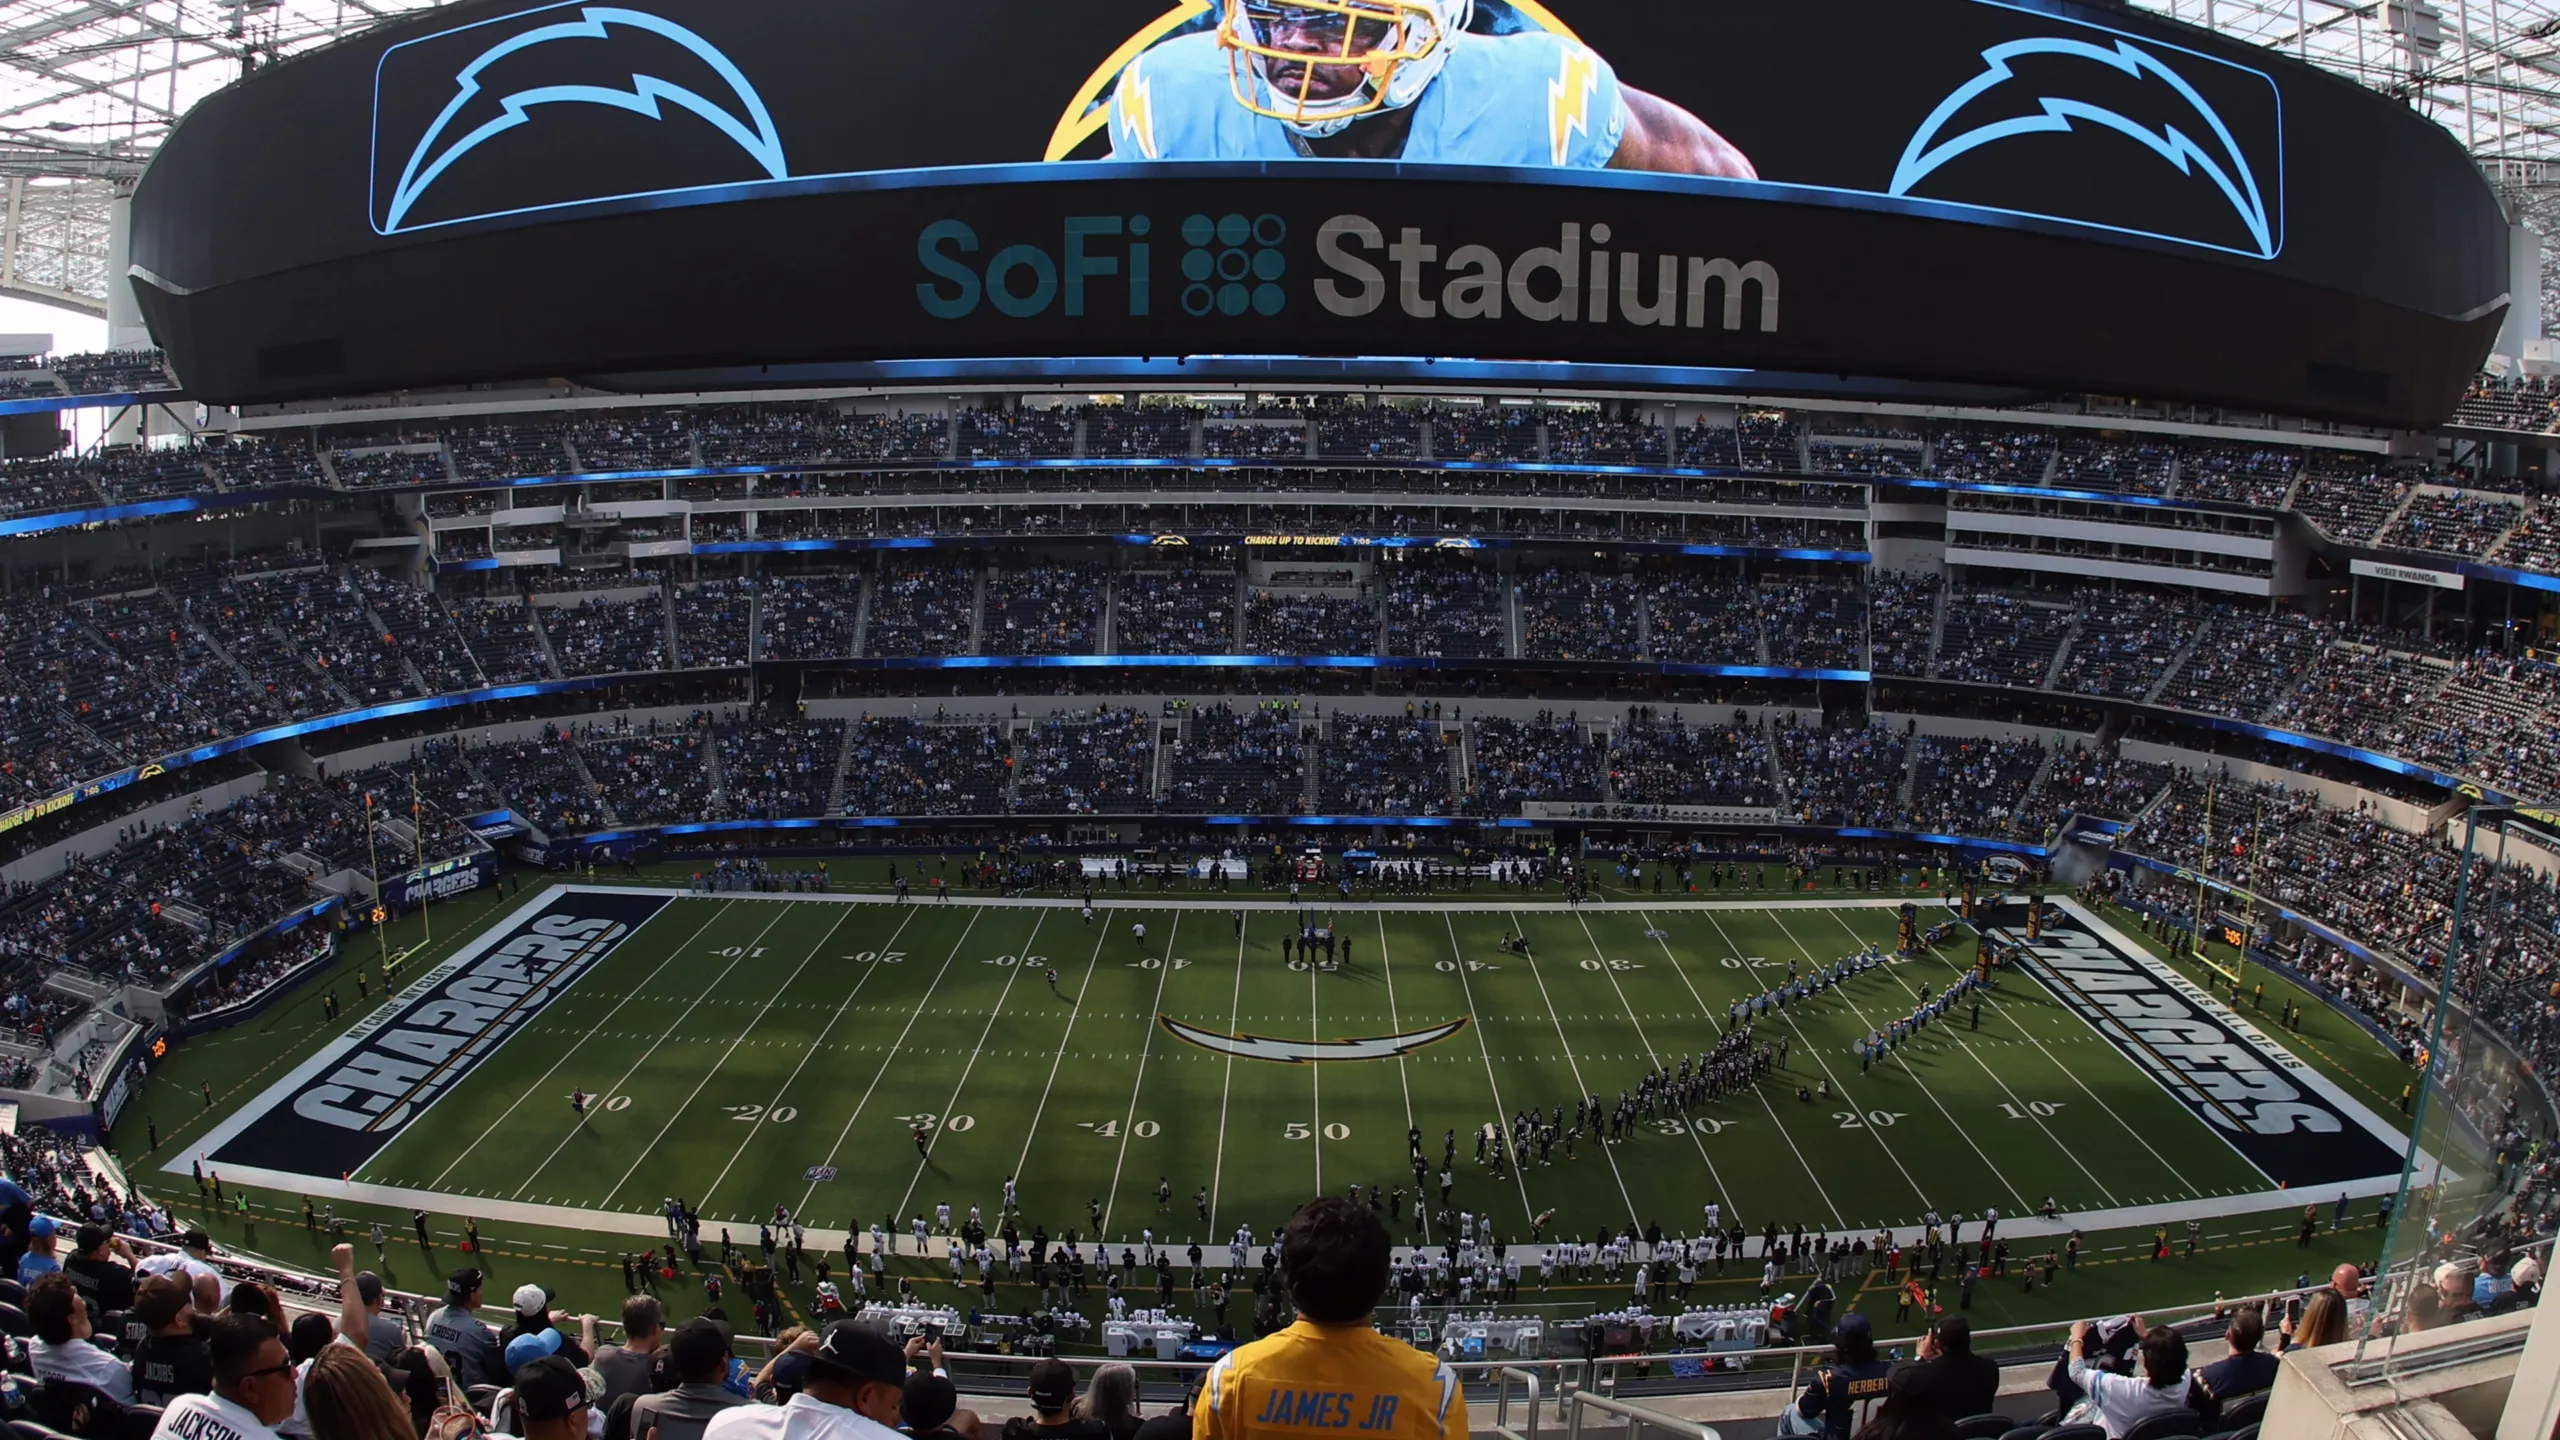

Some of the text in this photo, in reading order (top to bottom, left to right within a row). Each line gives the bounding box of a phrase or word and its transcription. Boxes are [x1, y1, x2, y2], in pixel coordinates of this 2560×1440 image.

[915, 213, 1779, 333] SoFi Stadium
[1244, 534, 1340, 546] CHARGE UP TO KICKOFF
[2375, 566, 2437, 583] VISIT RWANDA
[24, 808, 35, 822] UP
[36, 803, 45, 818] TO
[46, 793, 74, 814] KICKOFF
[405, 867, 479, 902] CHARGERS
[371, 907, 386, 922] 25
[345, 964, 457, 1040] MY CAUSE MY CLEATS
[2144, 961, 2305, 1069] IT TAKES ALL OF US
[293, 914, 627, 1133] CHARGERS
[1986, 926, 2343, 1135] CHARGERS
[431, 1323, 462, 1344] CROSBY
[144, 1361, 174, 1384] JACOBS
[1848, 1377, 1889, 1396] HERBERT
[1257, 1388, 1399, 1430] JAMES JR
